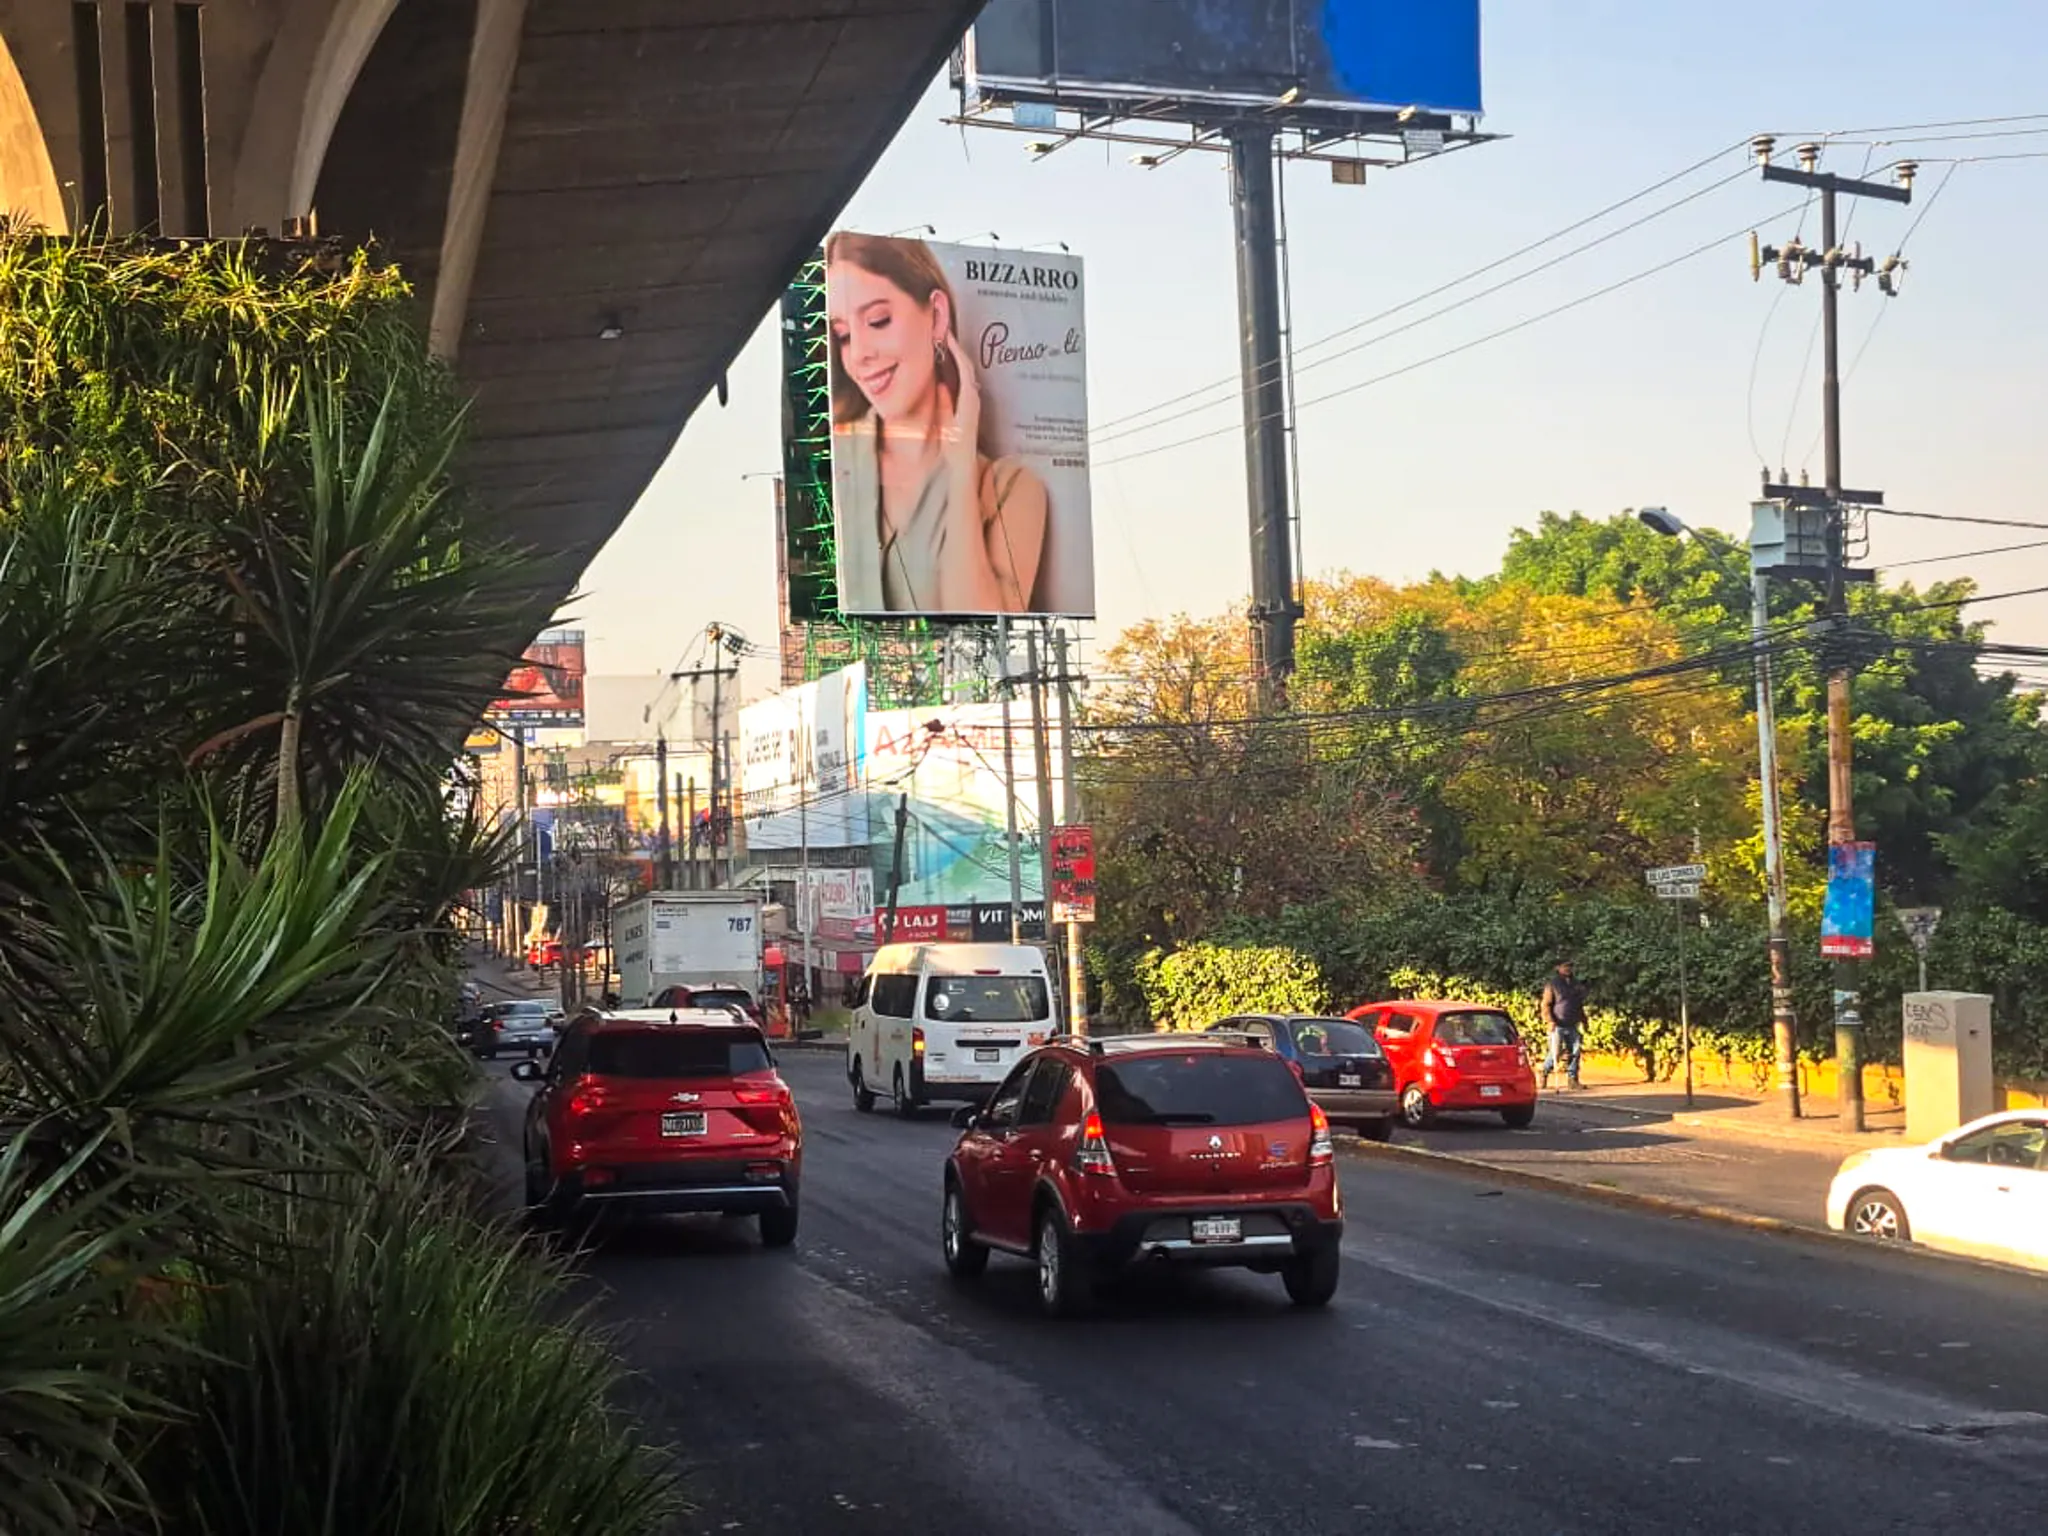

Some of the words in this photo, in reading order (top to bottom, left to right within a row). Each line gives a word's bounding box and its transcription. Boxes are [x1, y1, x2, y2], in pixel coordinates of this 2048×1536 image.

[966, 260, 1079, 291] BIZZARRO
[980, 322, 1047, 369] Pienso
[727, 917, 752, 932] 787
